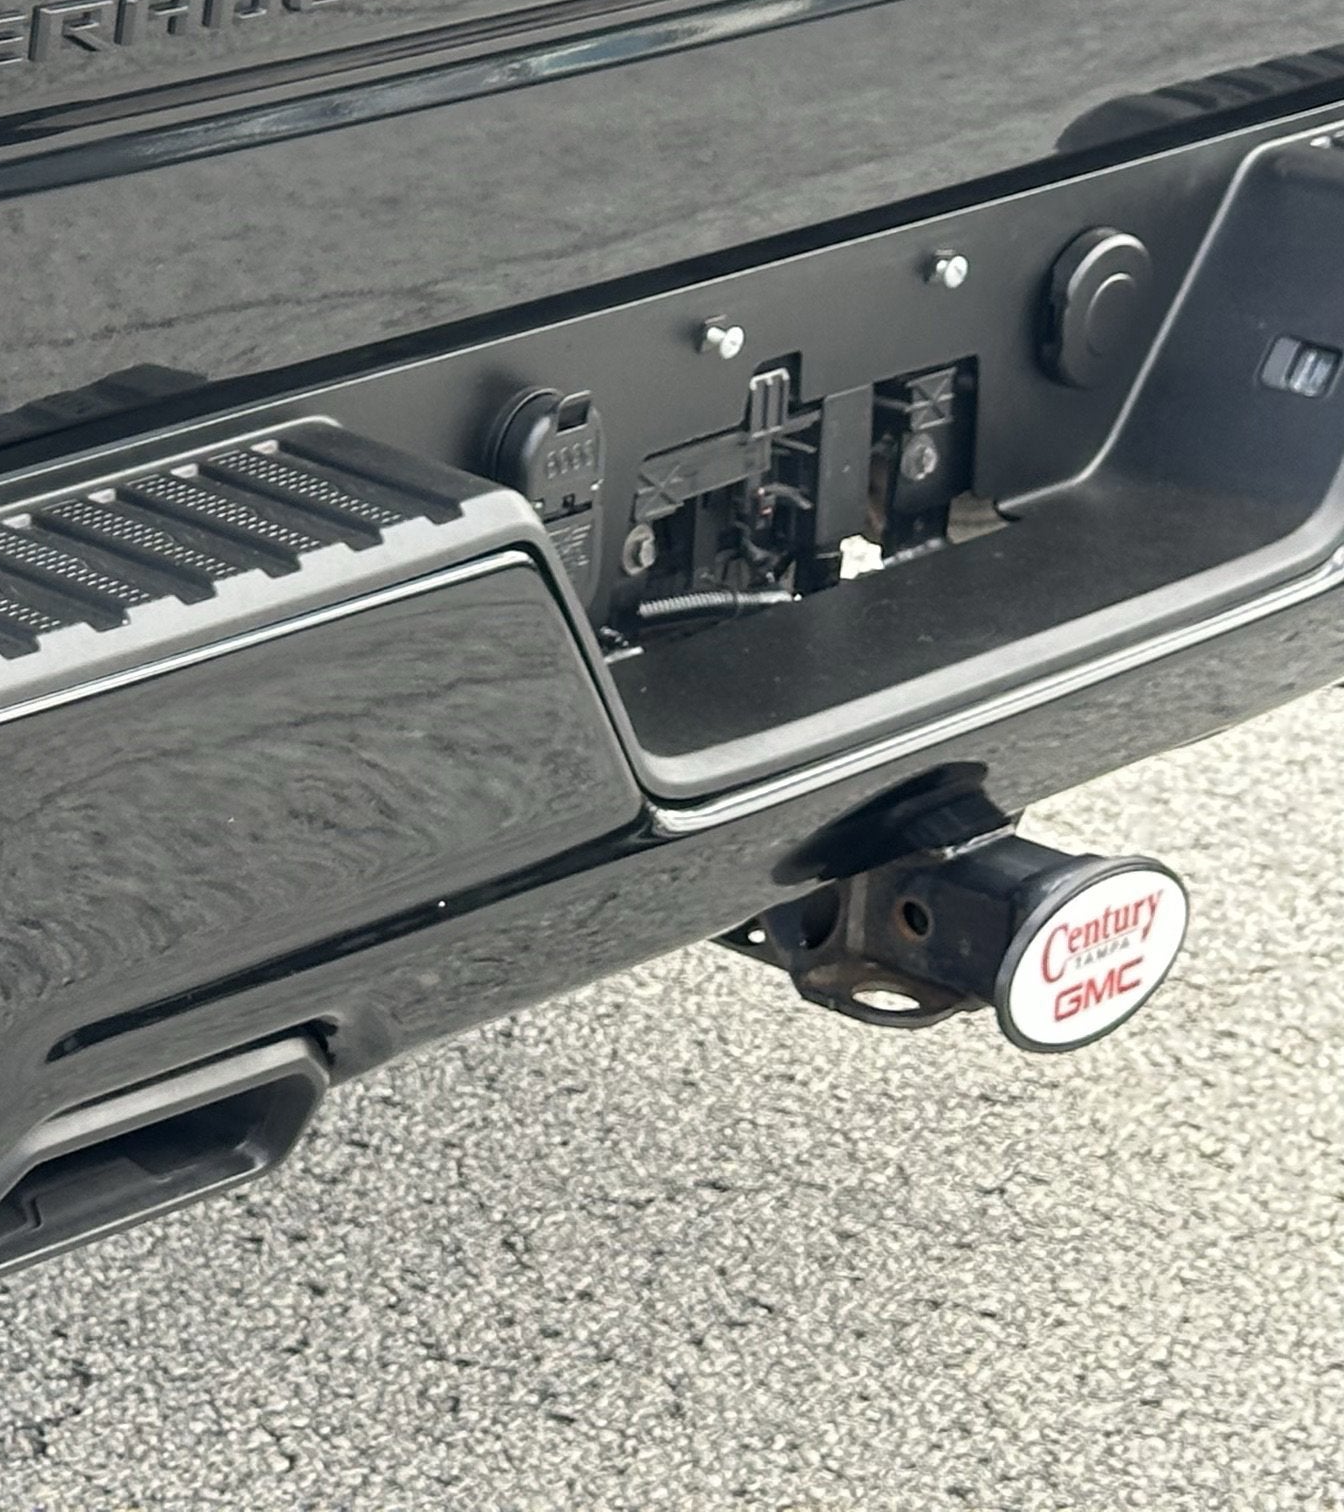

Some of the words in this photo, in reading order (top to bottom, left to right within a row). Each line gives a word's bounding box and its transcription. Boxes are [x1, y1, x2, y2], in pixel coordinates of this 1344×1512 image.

[1040, 888, 1164, 984] Century
[1075, 937, 1131, 969] TAMPA
[1053, 955, 1145, 1023] GMC
